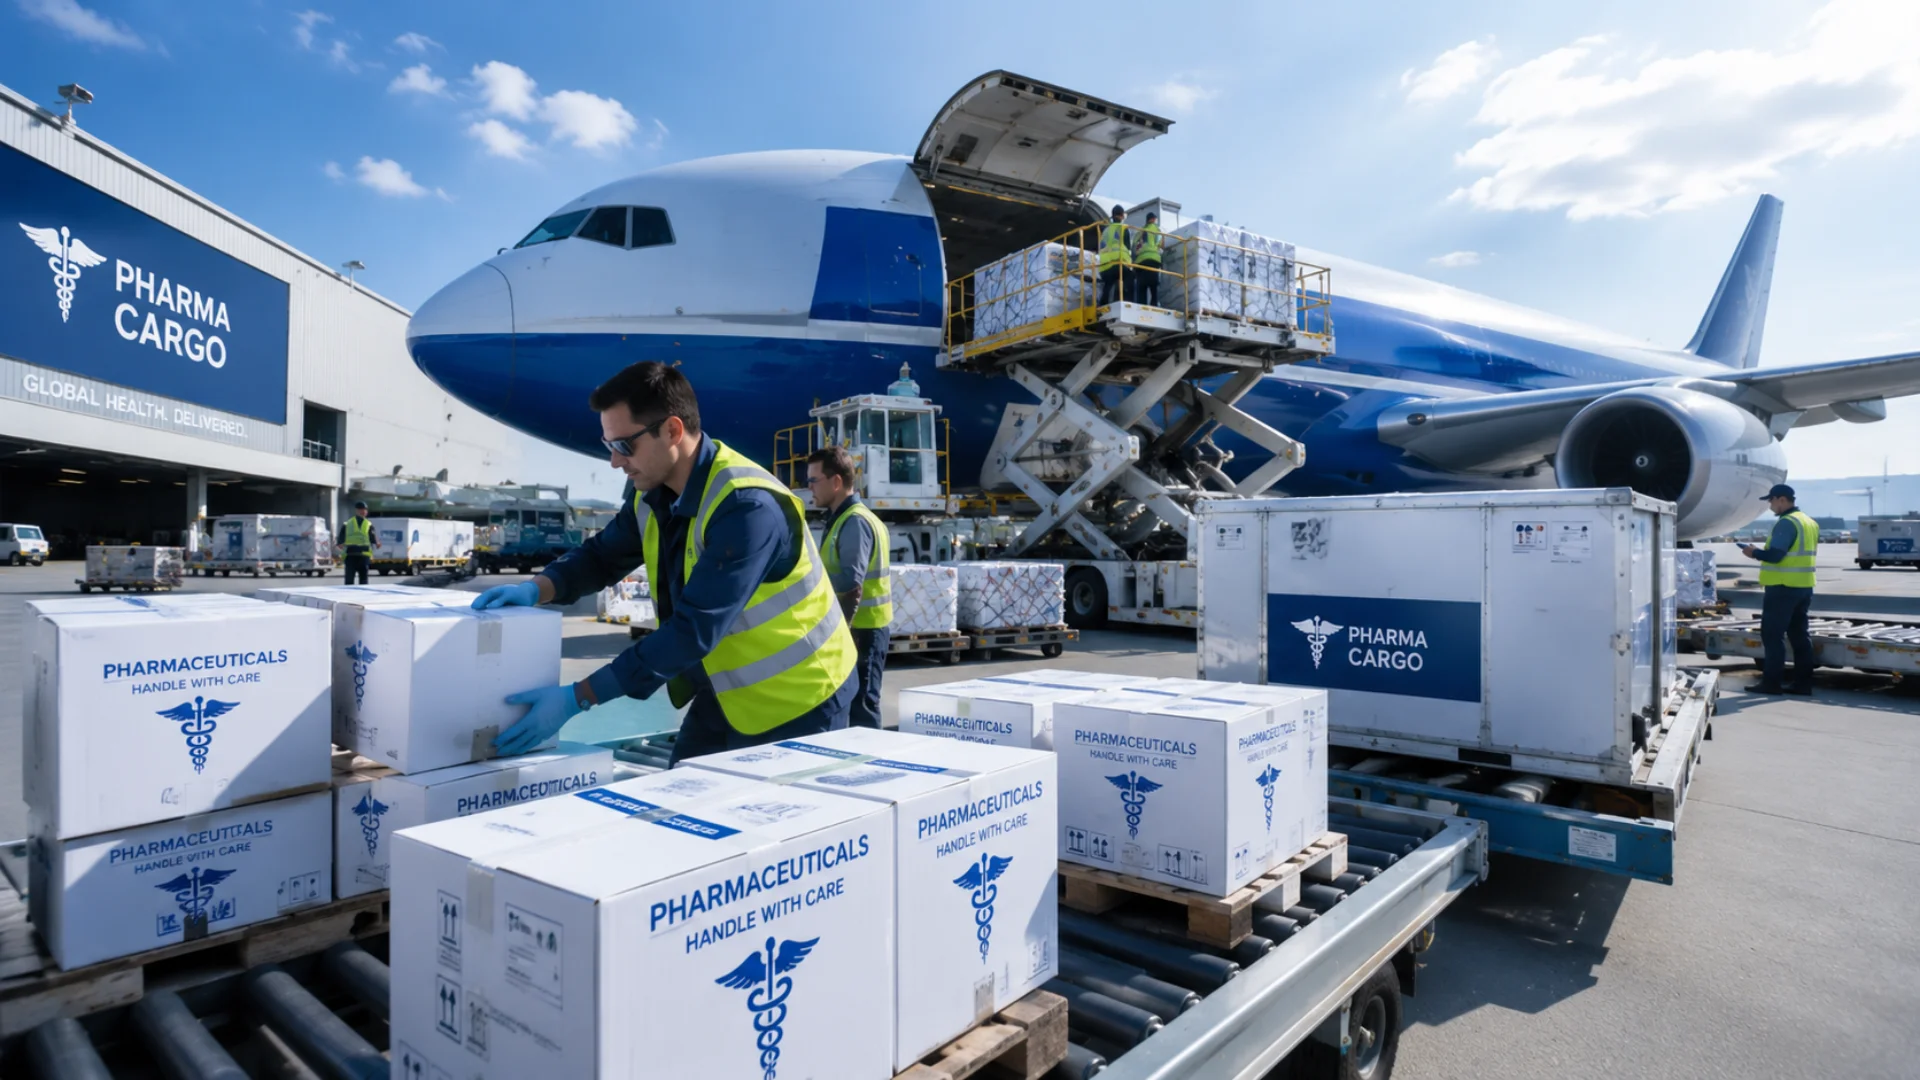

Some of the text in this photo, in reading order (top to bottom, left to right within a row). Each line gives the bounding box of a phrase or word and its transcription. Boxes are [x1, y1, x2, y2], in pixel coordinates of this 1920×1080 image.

[116, 259, 231, 332] PHARMA
[115, 303, 227, 369] CARGO
[23, 374, 248, 438] GLOBAL HEALTH. DELIVERED.
[1348, 626, 1428, 649] PHARMA
[103, 649, 288, 679] PHARMACEUTICALS
[1348, 647, 1424, 672] CARGO
[132, 671, 261, 695] HANDLE WITH CARE
[1075, 729, 1197, 756] PHARMACEUTICALS
[1126, 754, 1149, 766] WITH
[1152, 758, 1178, 770] CARE
[457, 771, 597, 813] PHARMCEUTICALS
[918, 780, 1043, 839] PHARMACEUTICALS
[936, 813, 1028, 859] HANDLE WITH CARE
[134, 855, 183, 875] HANDLE
[219, 842, 251, 857] CARE
[650, 834, 869, 932] PHARMACEUTICALS
[686, 877, 844, 954] HANDLE WITH CARE
